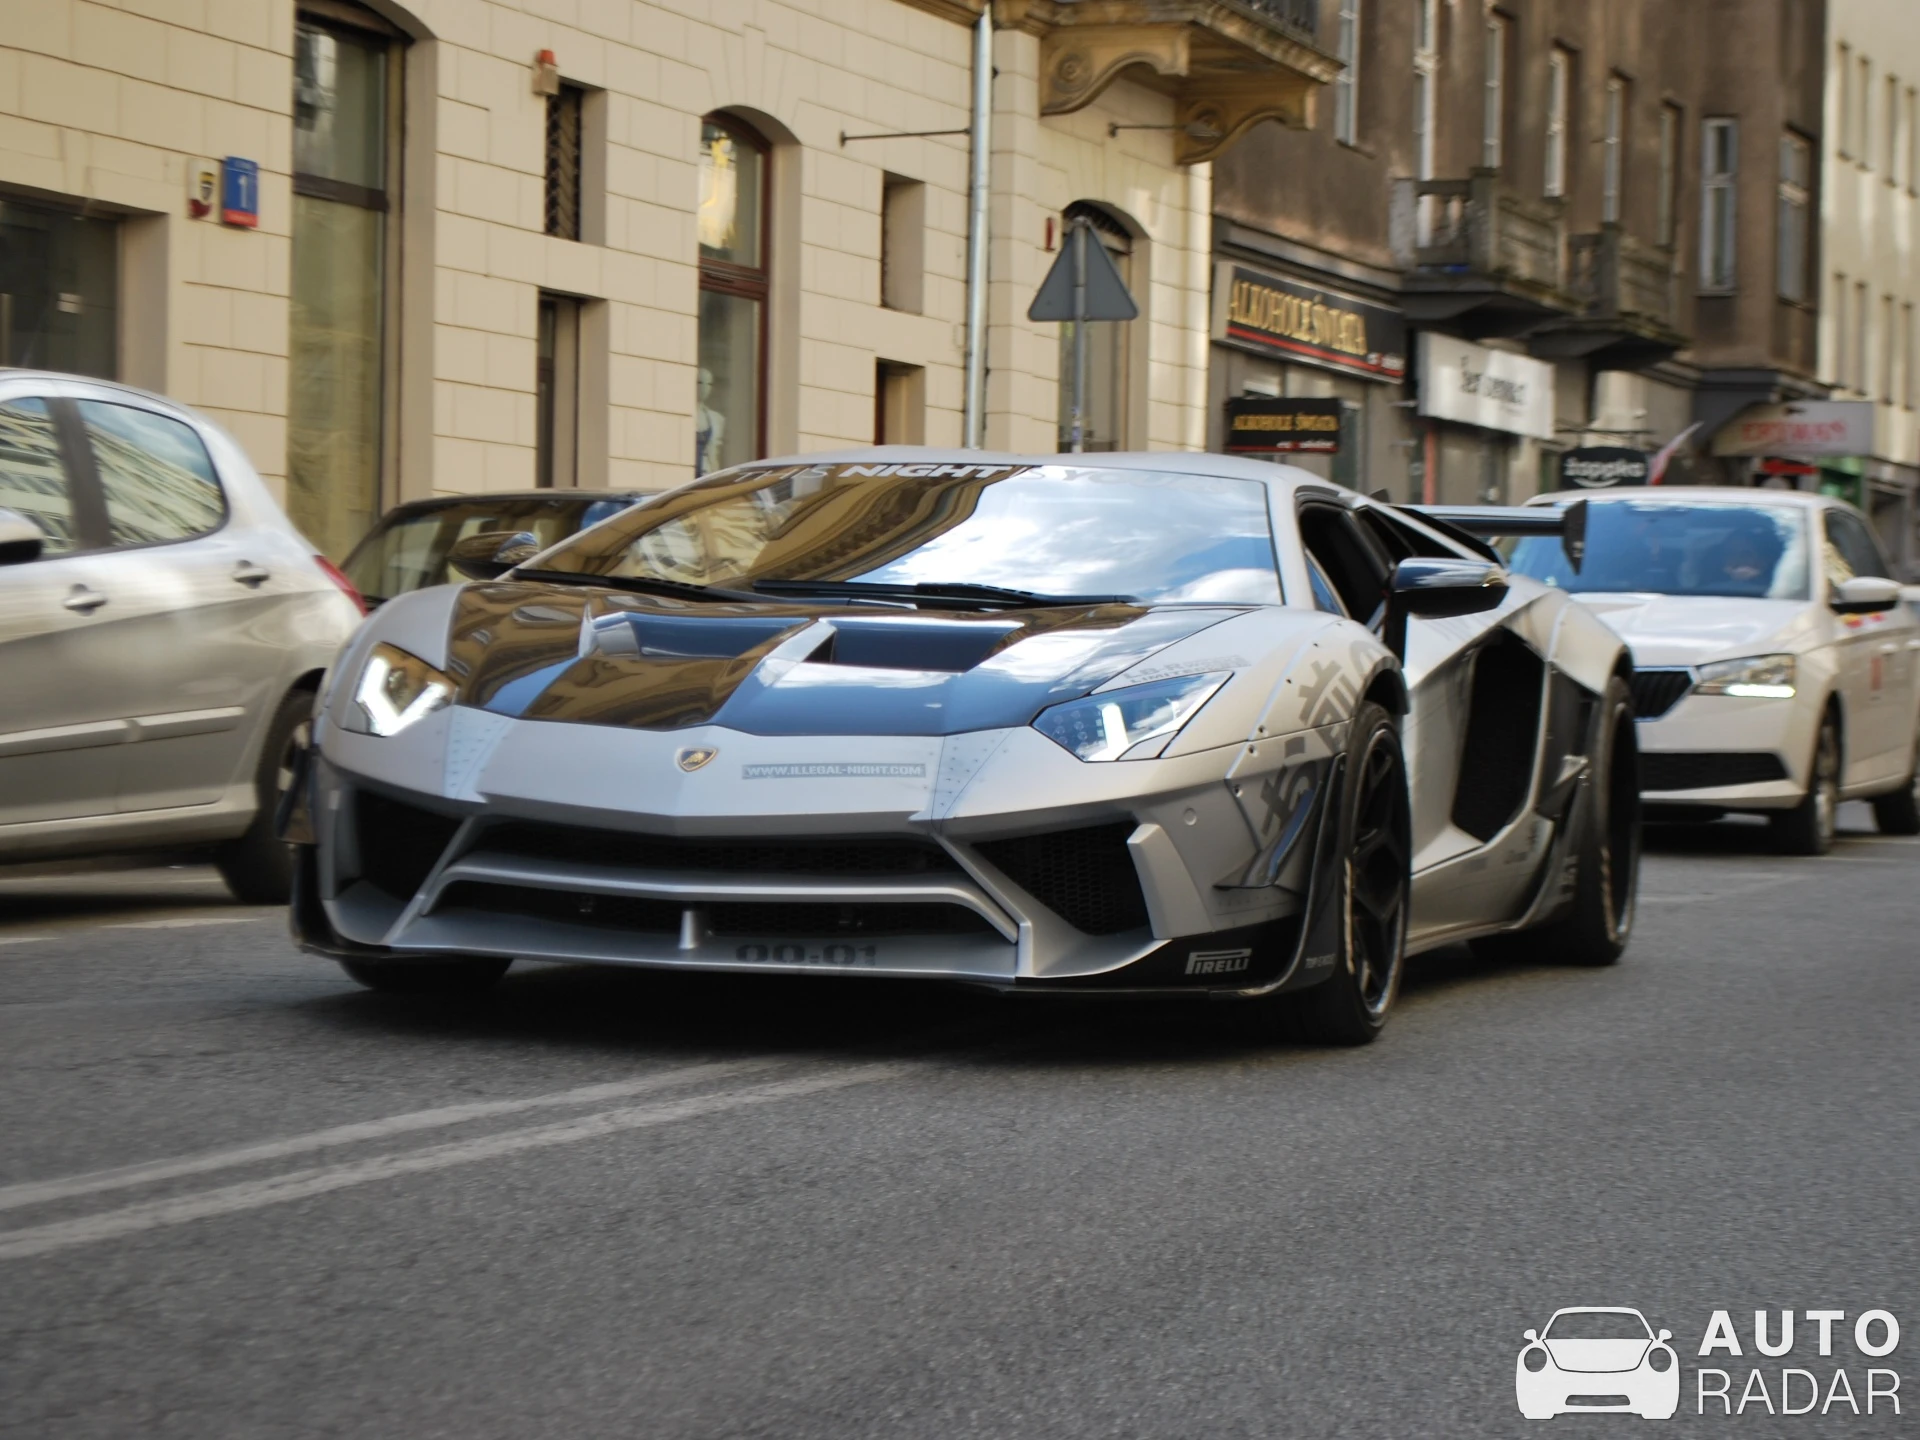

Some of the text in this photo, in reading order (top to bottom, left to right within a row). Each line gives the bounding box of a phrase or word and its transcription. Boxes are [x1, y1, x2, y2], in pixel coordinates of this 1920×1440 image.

[734, 465, 836, 483] THIS
[838, 463, 1006, 478] NIGHT
[746, 764, 922, 777] WWW.ILLEGAL-NIGHT.COM
[1185, 949, 1252, 975] PIRELLI
